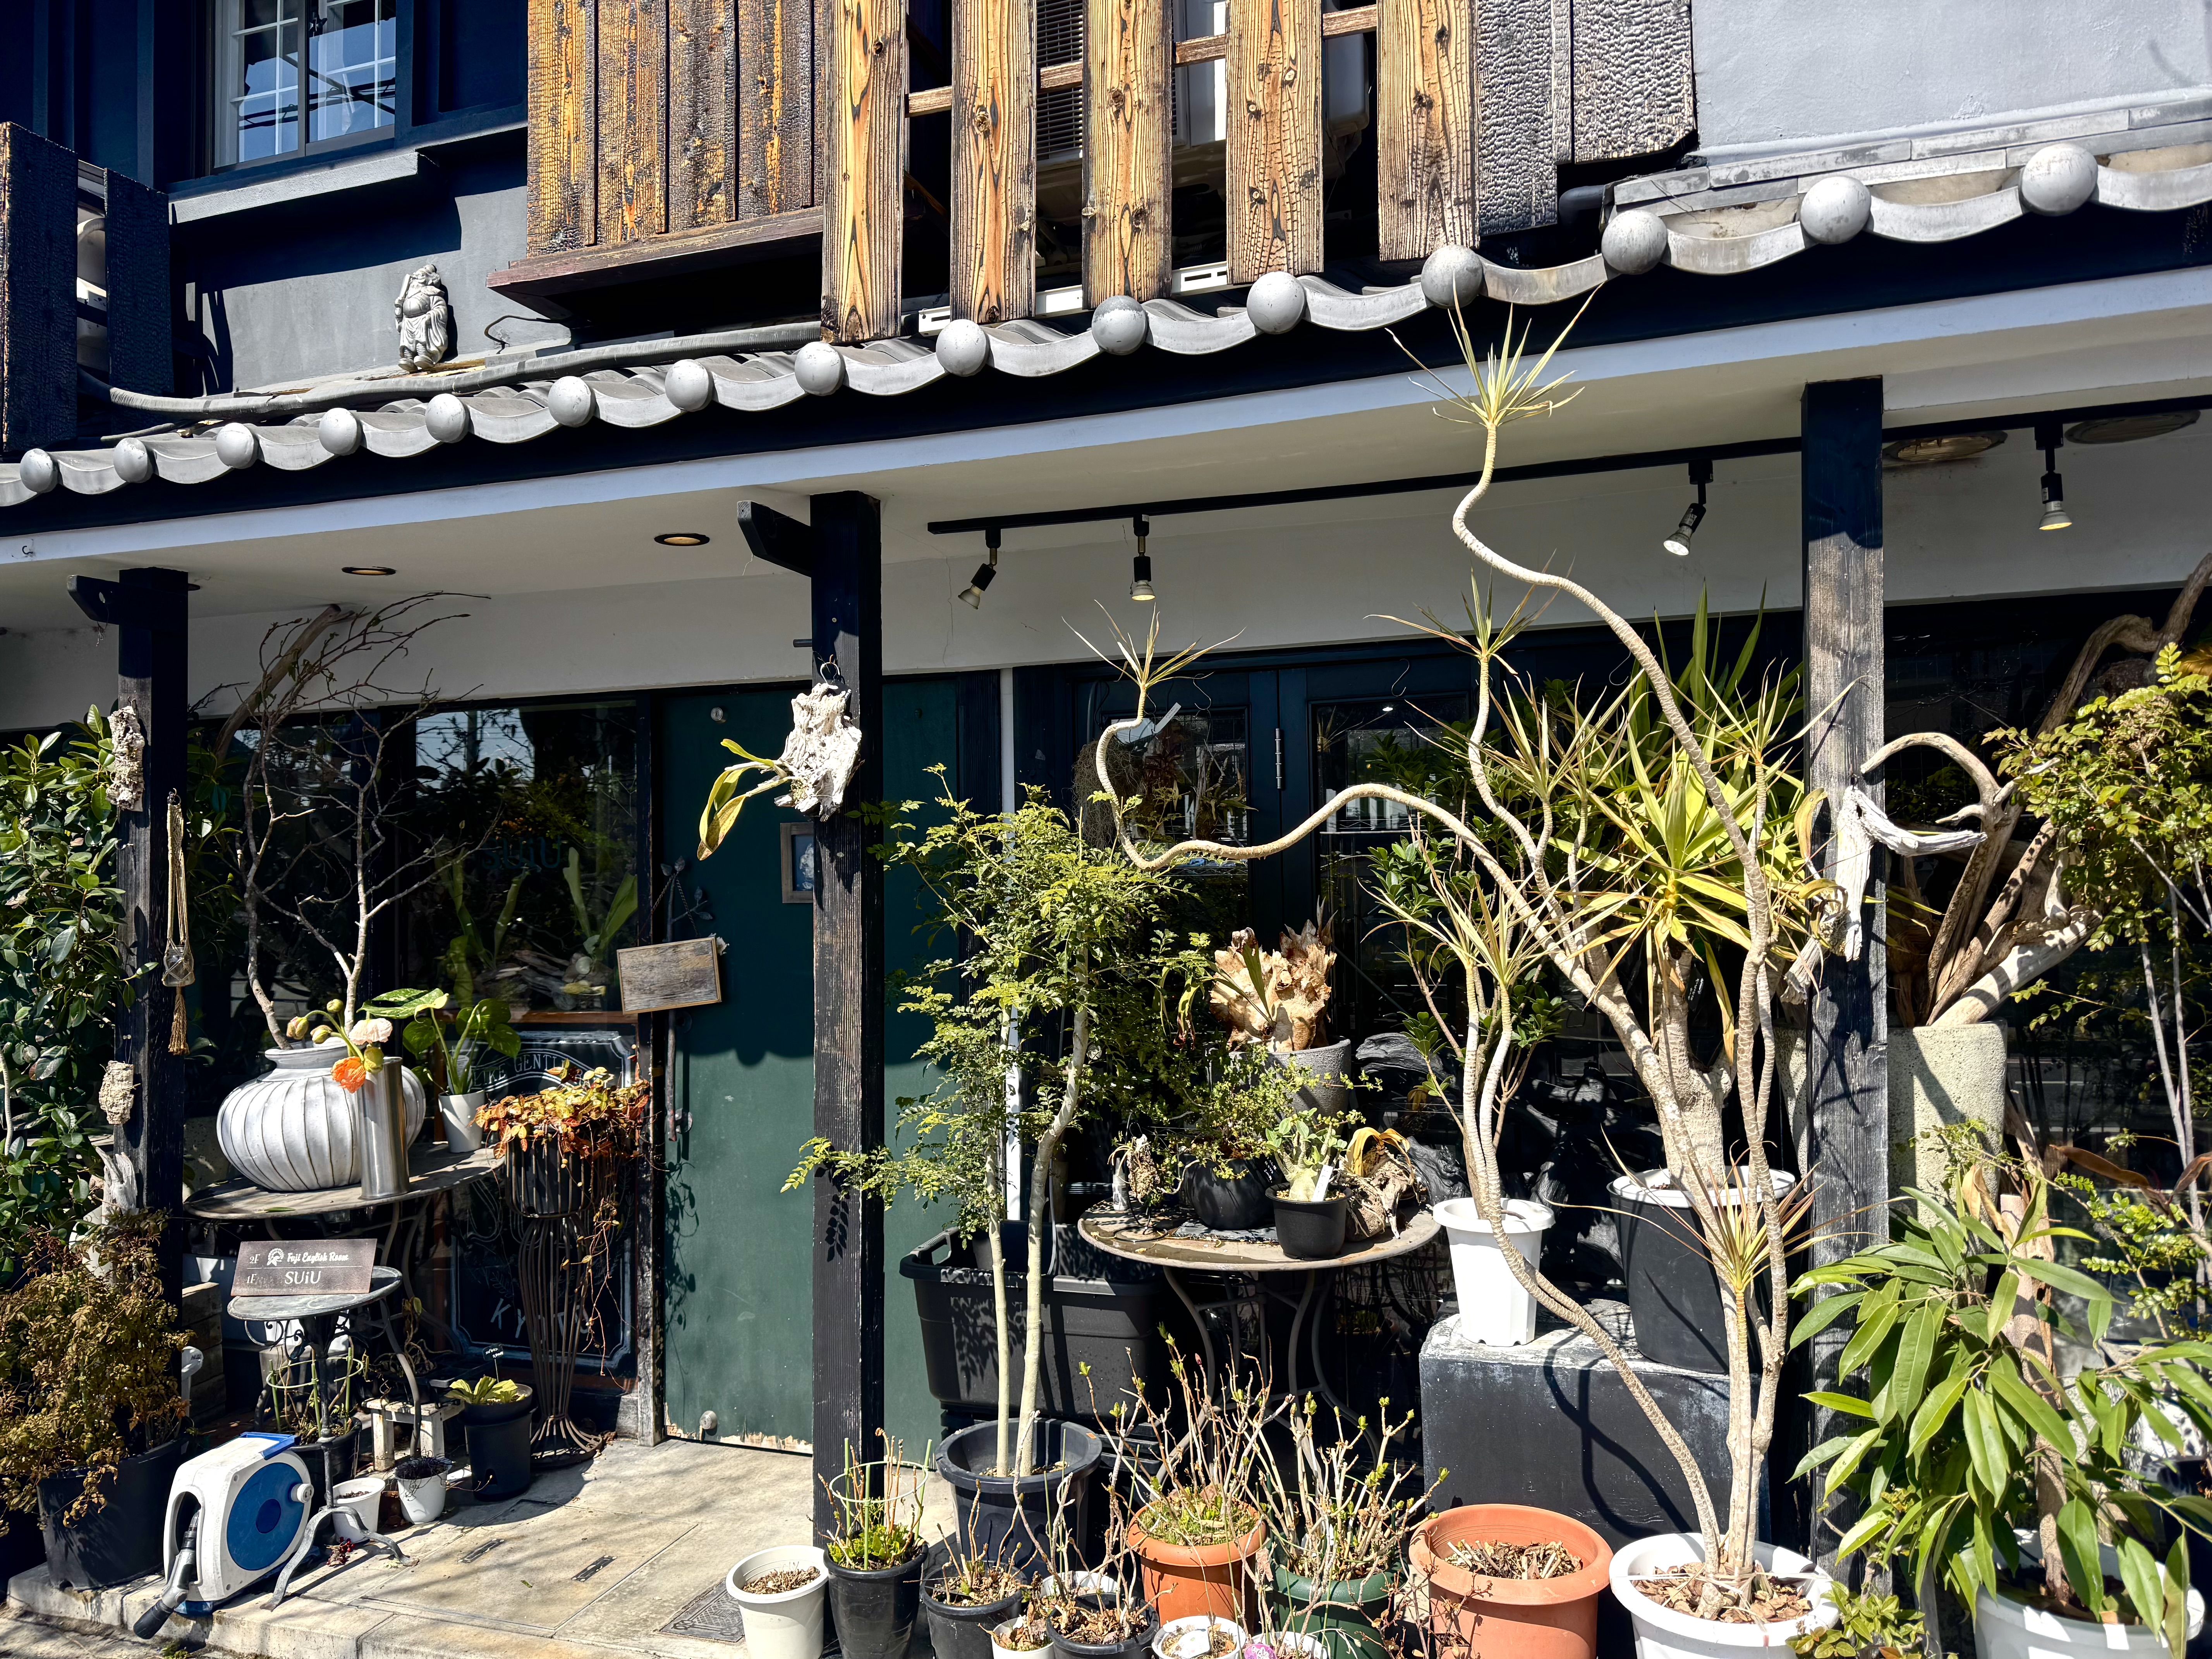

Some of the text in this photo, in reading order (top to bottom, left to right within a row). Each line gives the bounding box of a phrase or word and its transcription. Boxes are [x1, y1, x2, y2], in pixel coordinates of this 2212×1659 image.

[473, 1063, 506, 1086] LIKE
[249, 1252, 349, 1264] 2F Fuji English Room
[246, 1271, 321, 1284] 1F SUiU
